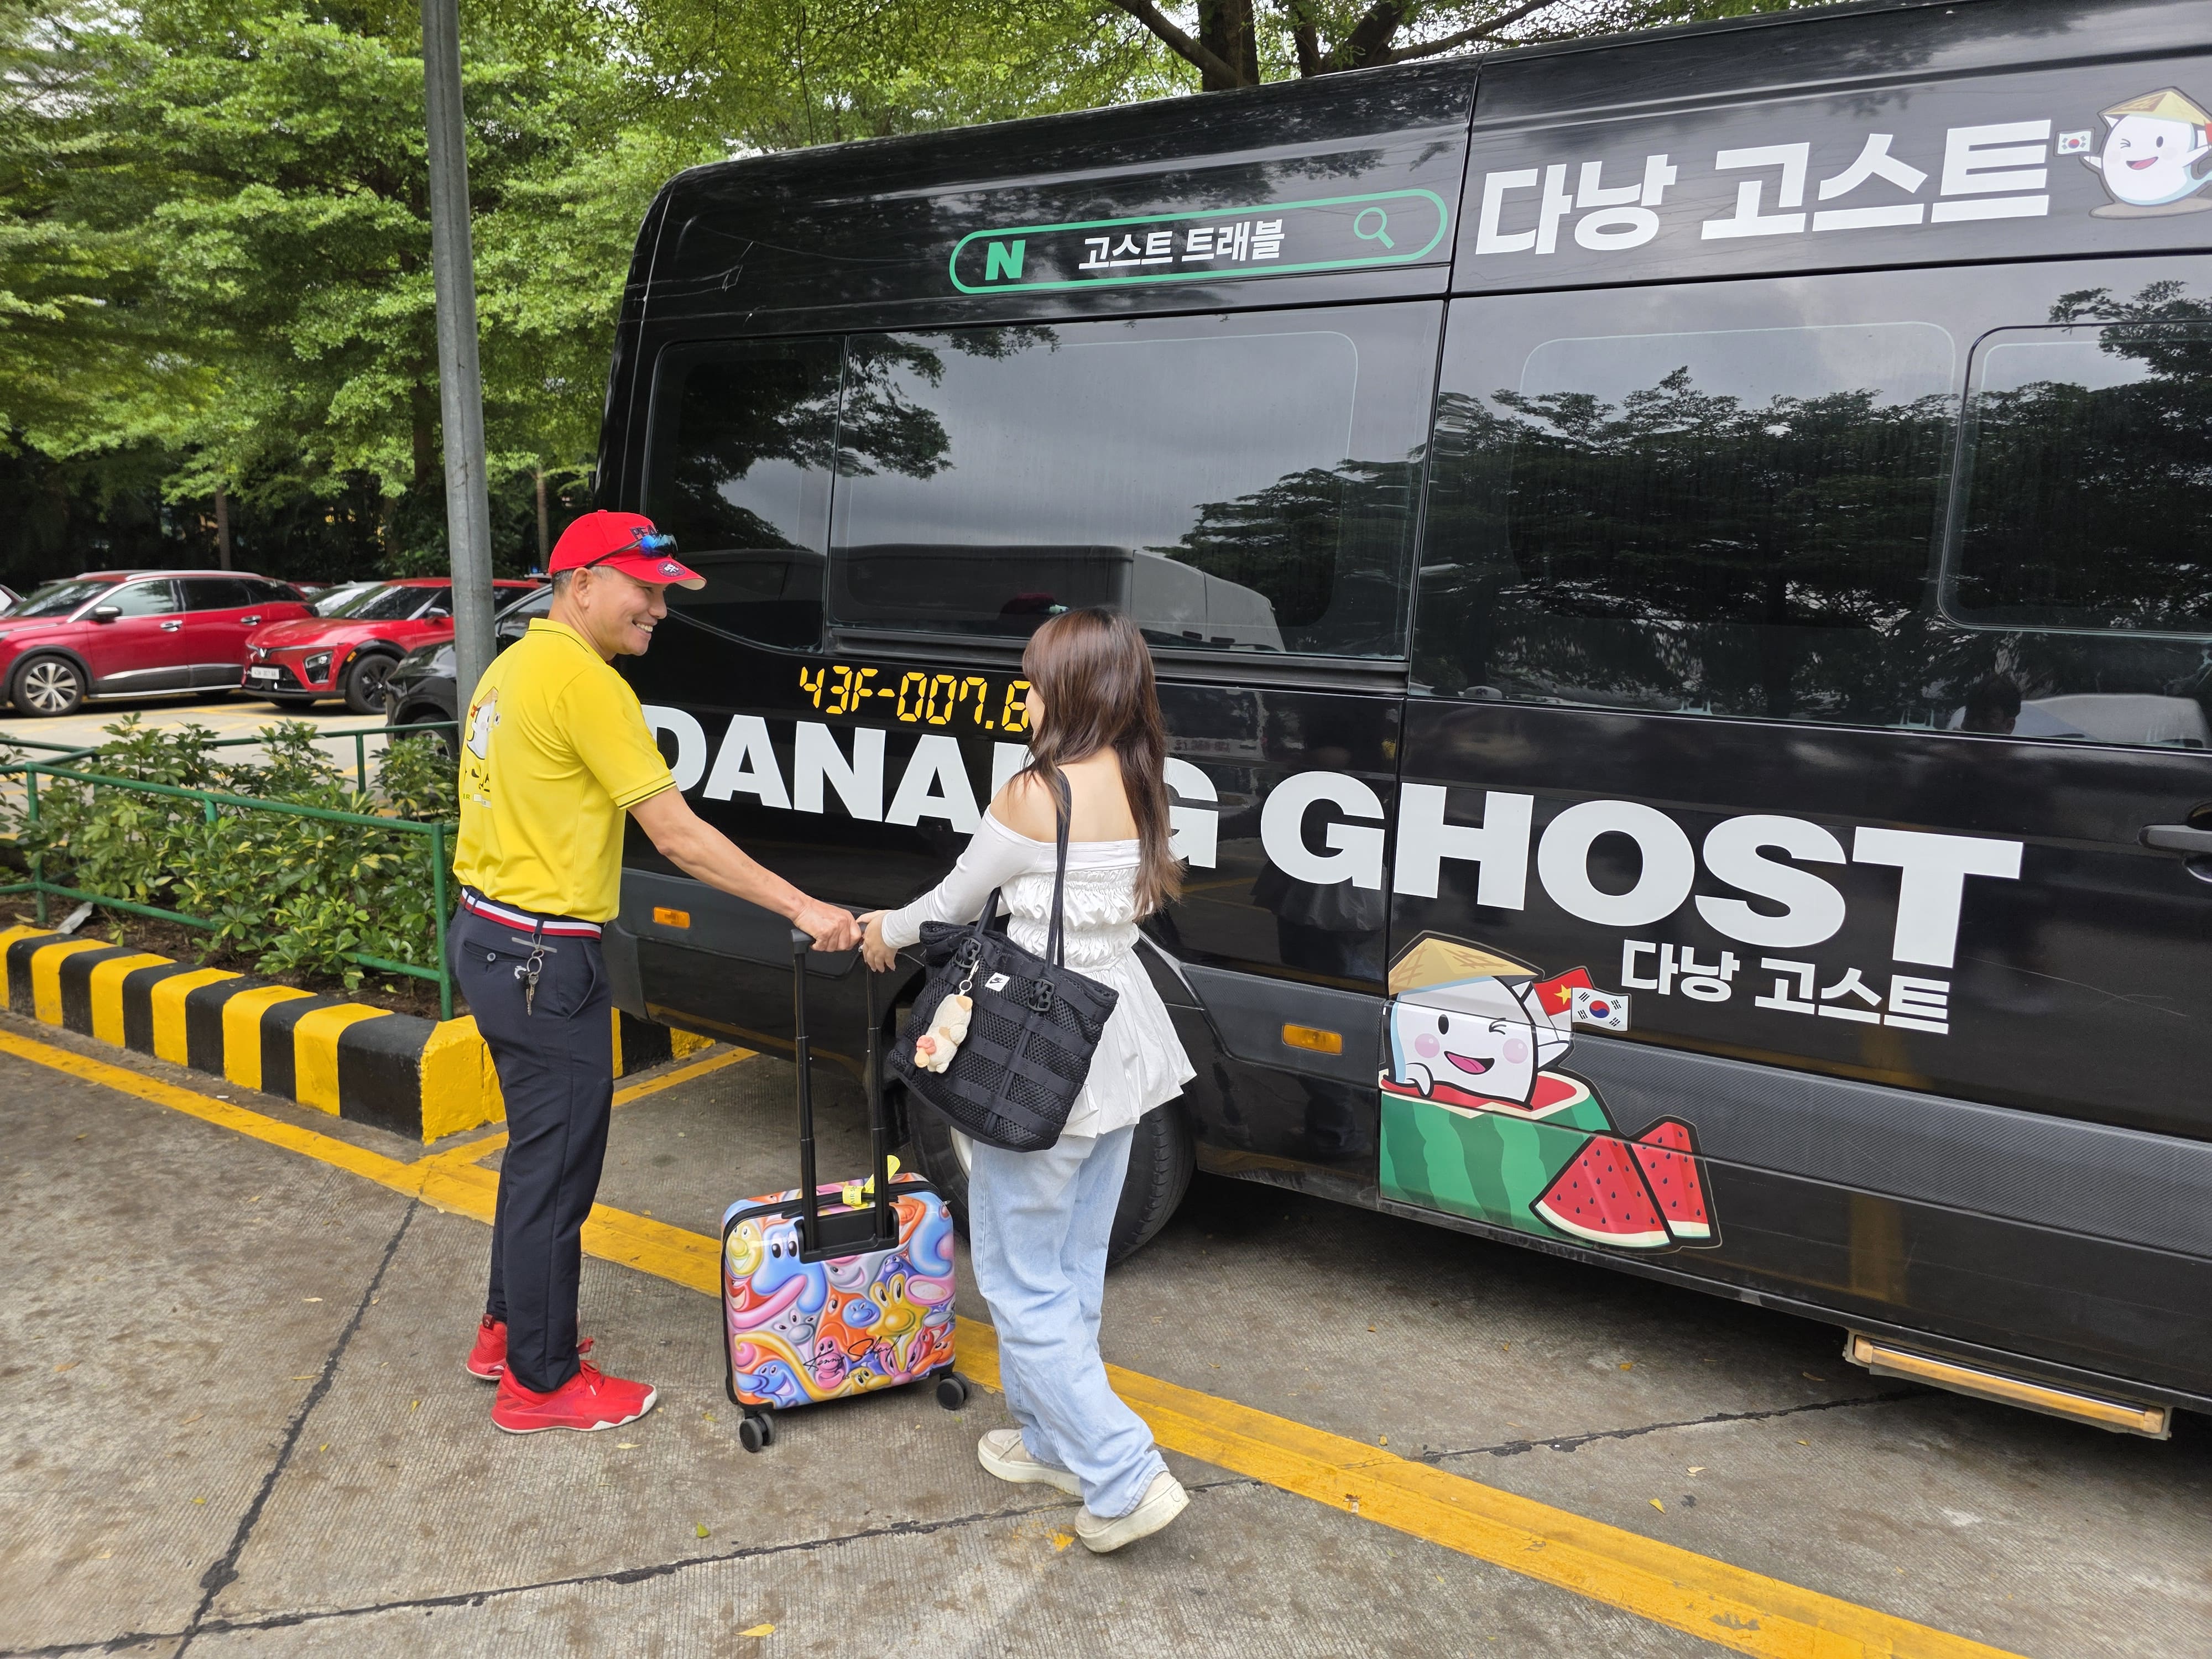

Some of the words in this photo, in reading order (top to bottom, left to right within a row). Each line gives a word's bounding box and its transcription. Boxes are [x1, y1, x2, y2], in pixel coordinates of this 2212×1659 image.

[1475, 154, 1678, 254] 다낭
[1700, 119, 2052, 240] 고스트
[985, 240, 1026, 281] N
[1079, 231, 1173, 269] 고스트
[1182, 219, 1285, 262] 트래블
[641, 705, 1219, 868] DANAG
[1261, 771, 2023, 968] GHOST
[1621, 940, 1740, 1001] 다낭
[1755, 958, 1950, 1035] 고스트
